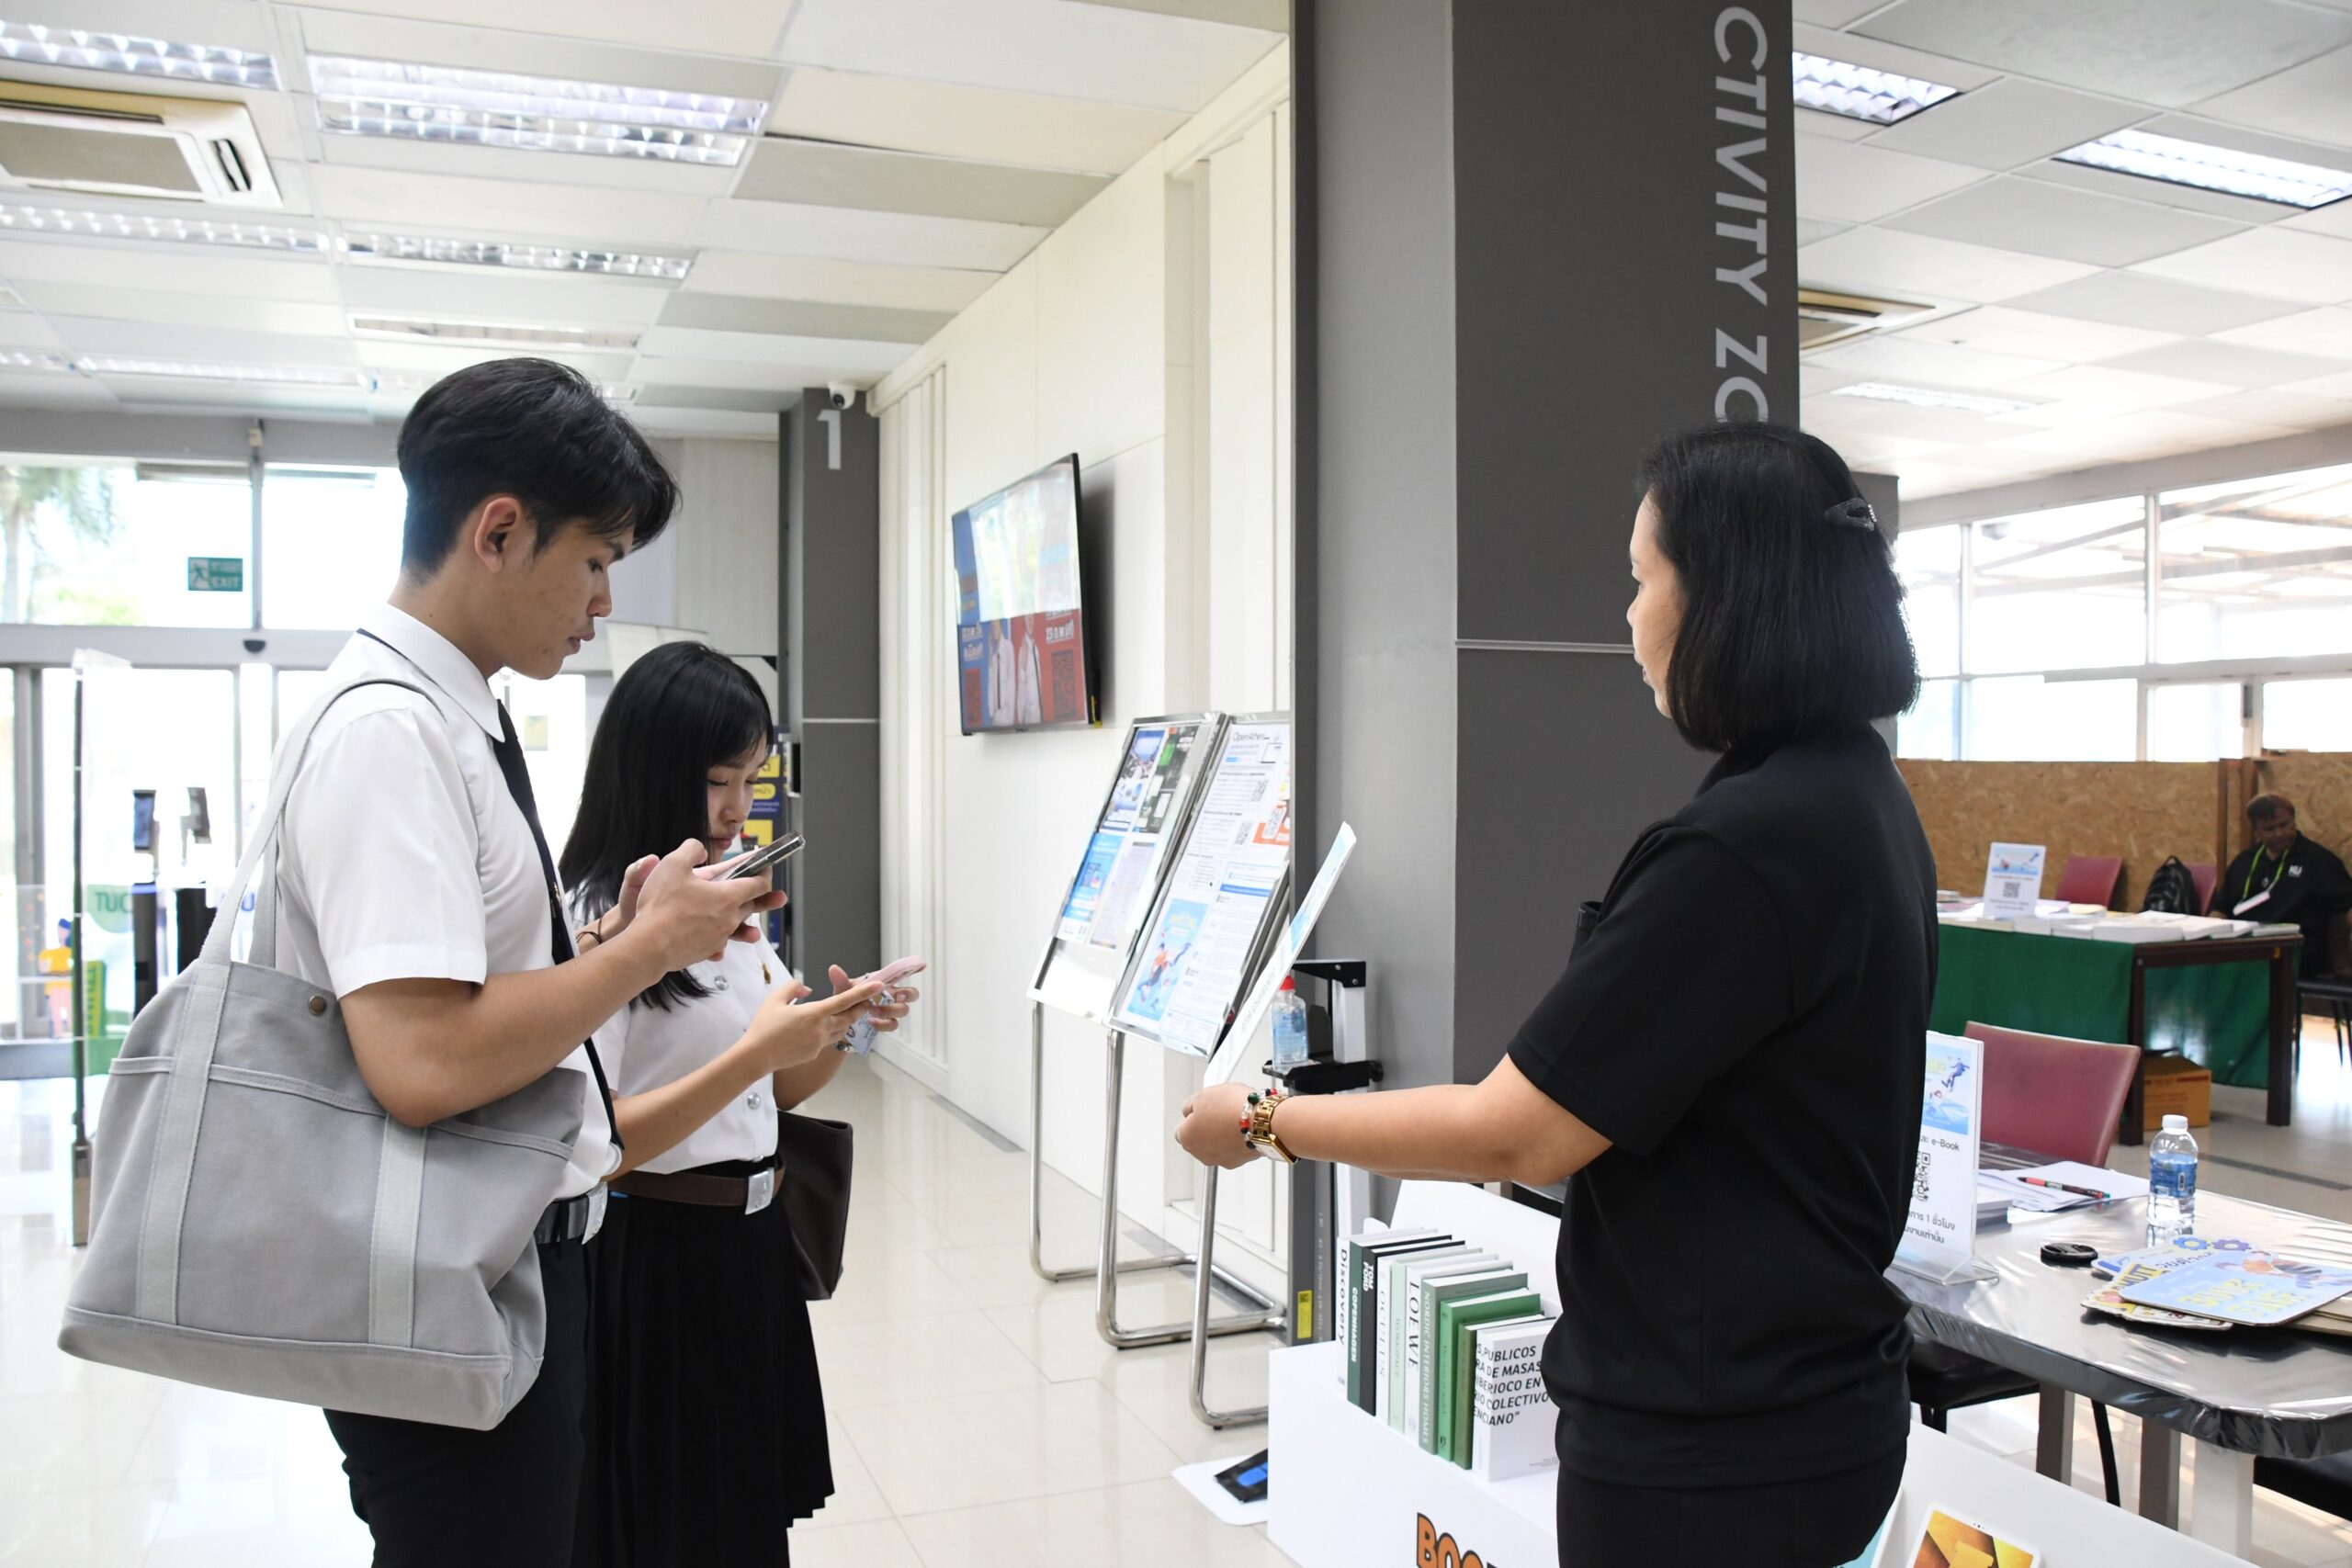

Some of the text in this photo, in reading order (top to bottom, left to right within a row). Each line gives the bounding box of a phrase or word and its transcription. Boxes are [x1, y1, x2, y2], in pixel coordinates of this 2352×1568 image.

[817, 410, 841, 470] 1
[1931, 1139, 1960, 1151] e-Book
[1338, 1249, 1348, 1345] Discovery
[1408, 1281, 1419, 1371] LOEWE
[1423, 1292, 1431, 1338] NORDIC
[1487, 1365, 1500, 1379] DE
[1501, 1360, 1542, 1377] MASAS
[1525, 1377, 1542, 1390] EN
[1487, 1391, 1549, 1410] COLECTIVO
